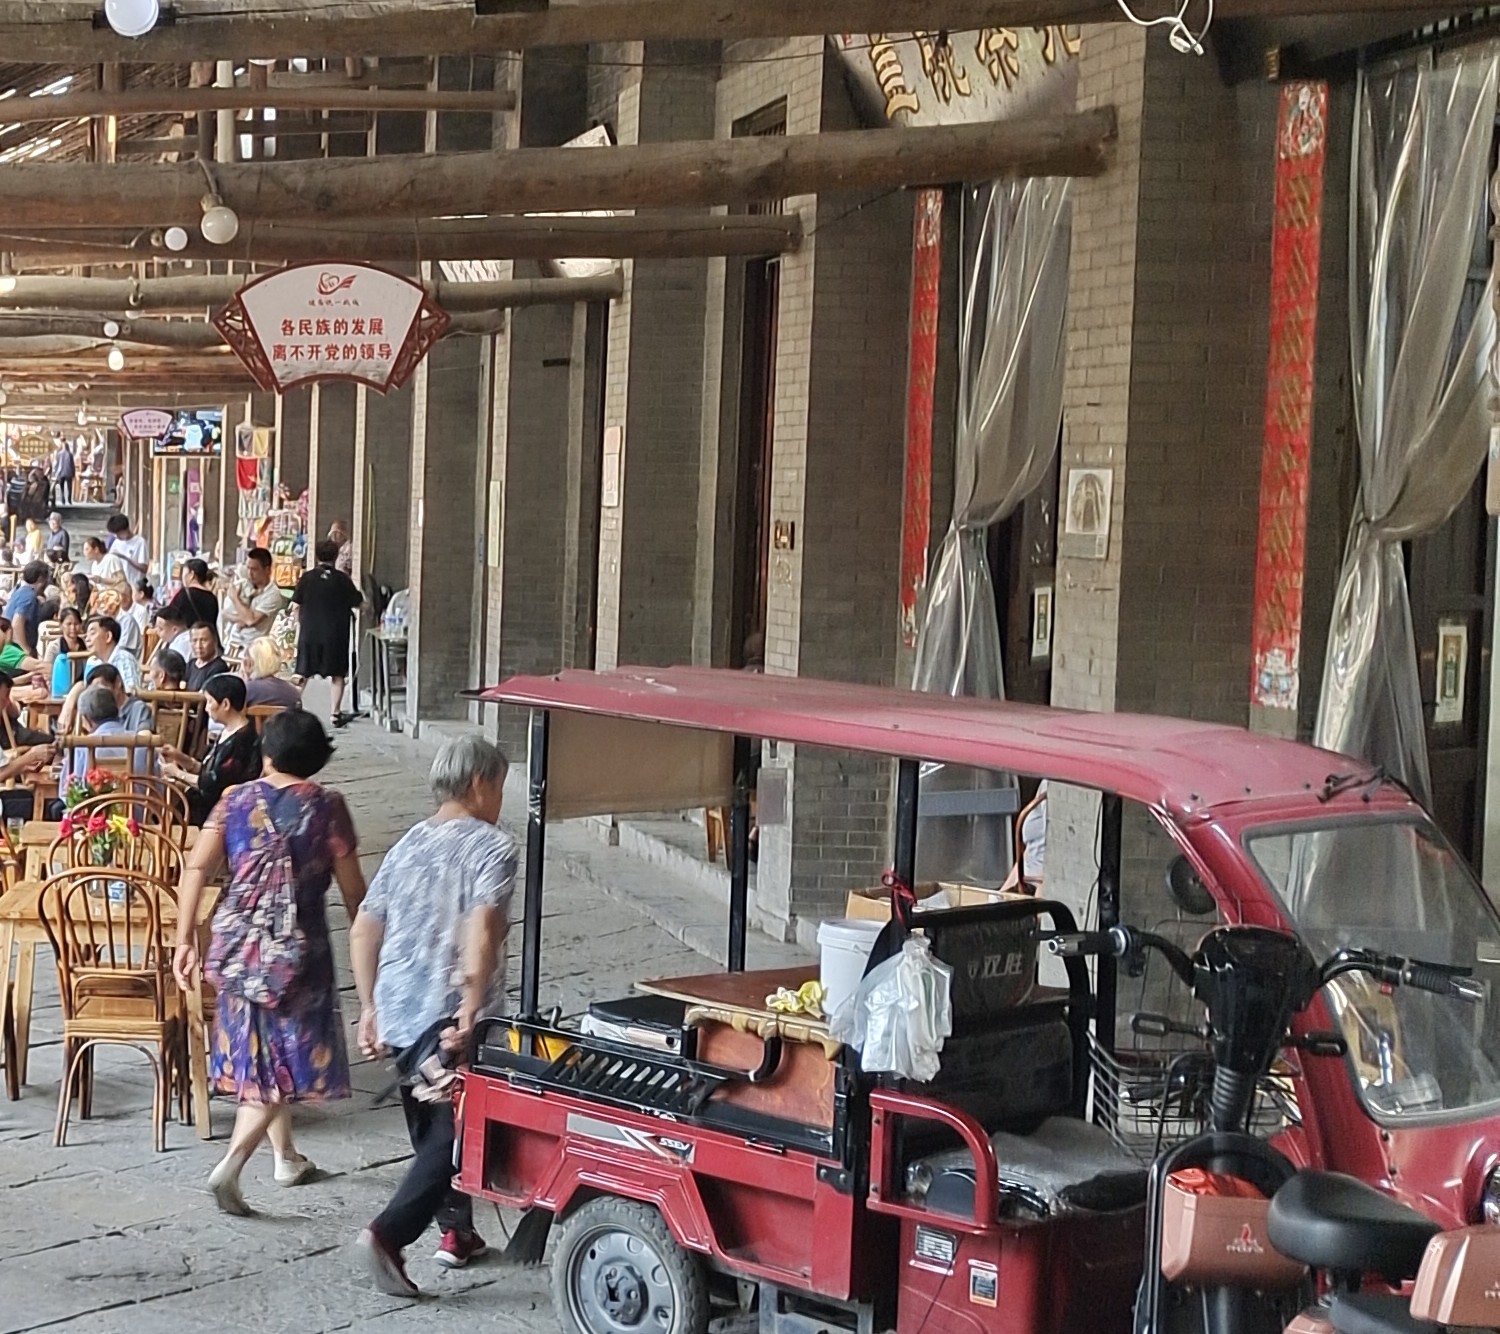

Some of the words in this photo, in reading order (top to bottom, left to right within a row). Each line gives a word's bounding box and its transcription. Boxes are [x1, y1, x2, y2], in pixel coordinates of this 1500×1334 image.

[280, 318, 385, 336] 各民族的发展
[272, 343, 393, 361] 离不开党的领导
[981, 951, 1023, 979] 双胜
